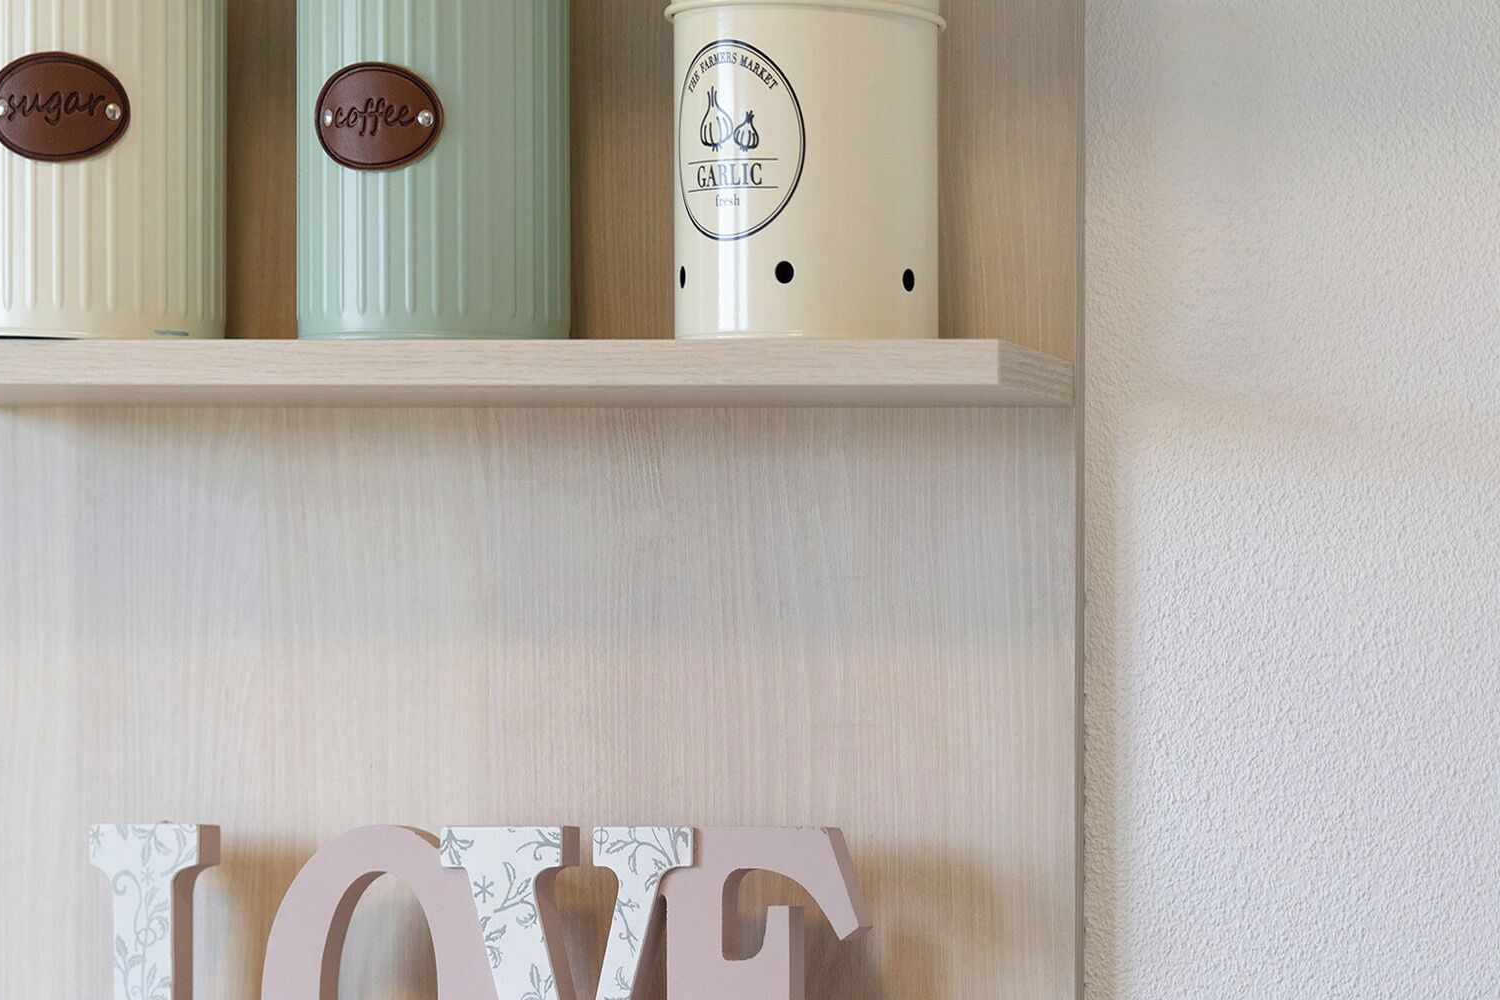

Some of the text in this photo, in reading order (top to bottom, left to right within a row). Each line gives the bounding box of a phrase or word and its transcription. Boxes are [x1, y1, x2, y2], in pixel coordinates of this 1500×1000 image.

[687, 52, 778, 93] THE FARMERS MARKET
[7, 90, 107, 126] sugar
[334, 97, 418, 137] coffee
[697, 162, 763, 188] GARLIC
[715, 192, 740, 207] fresh
